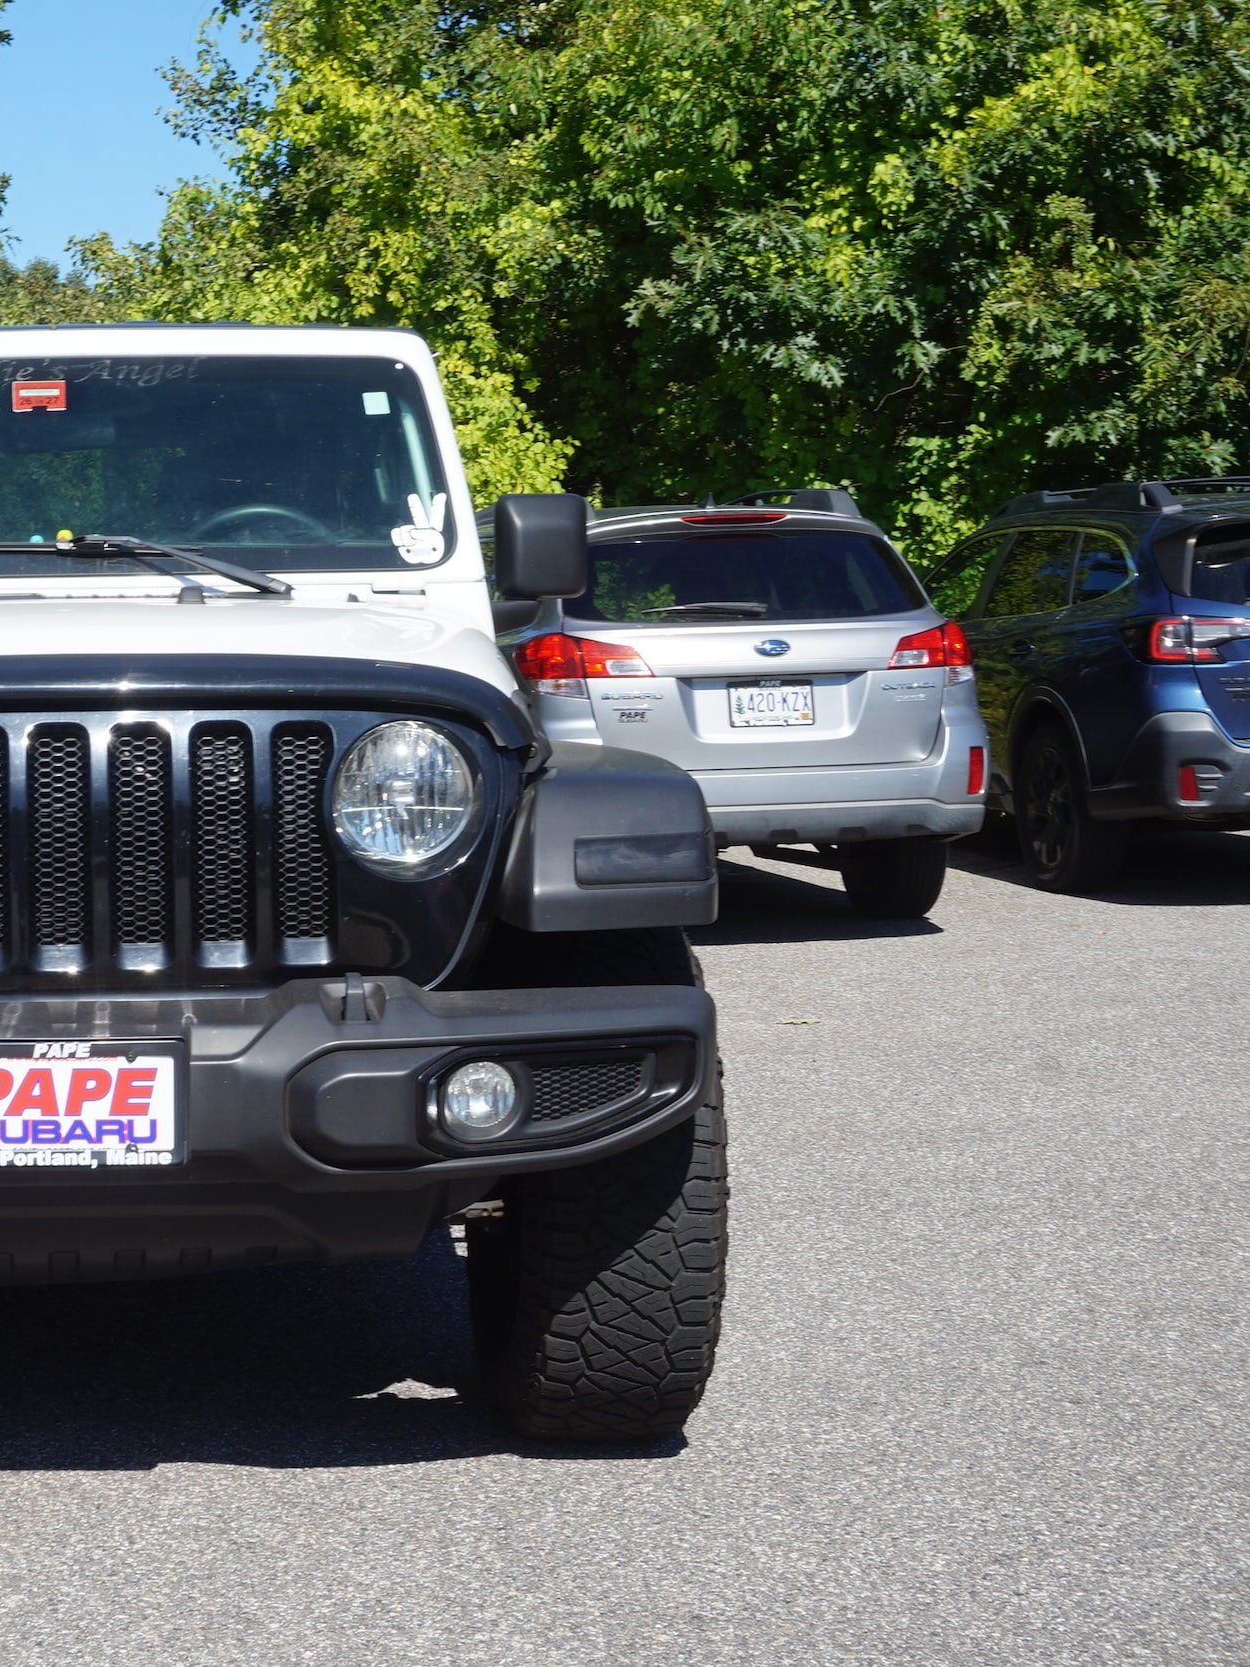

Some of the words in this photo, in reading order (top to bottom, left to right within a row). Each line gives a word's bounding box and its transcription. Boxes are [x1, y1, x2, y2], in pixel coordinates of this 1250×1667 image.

[74, 355, 201, 387] Angel
[618, 711, 648, 719] PAPE
[32, 1042, 93, 1060] PAPE
[0, 1149, 99, 1169] Portland,
[106, 1150, 173, 1166] Maine
